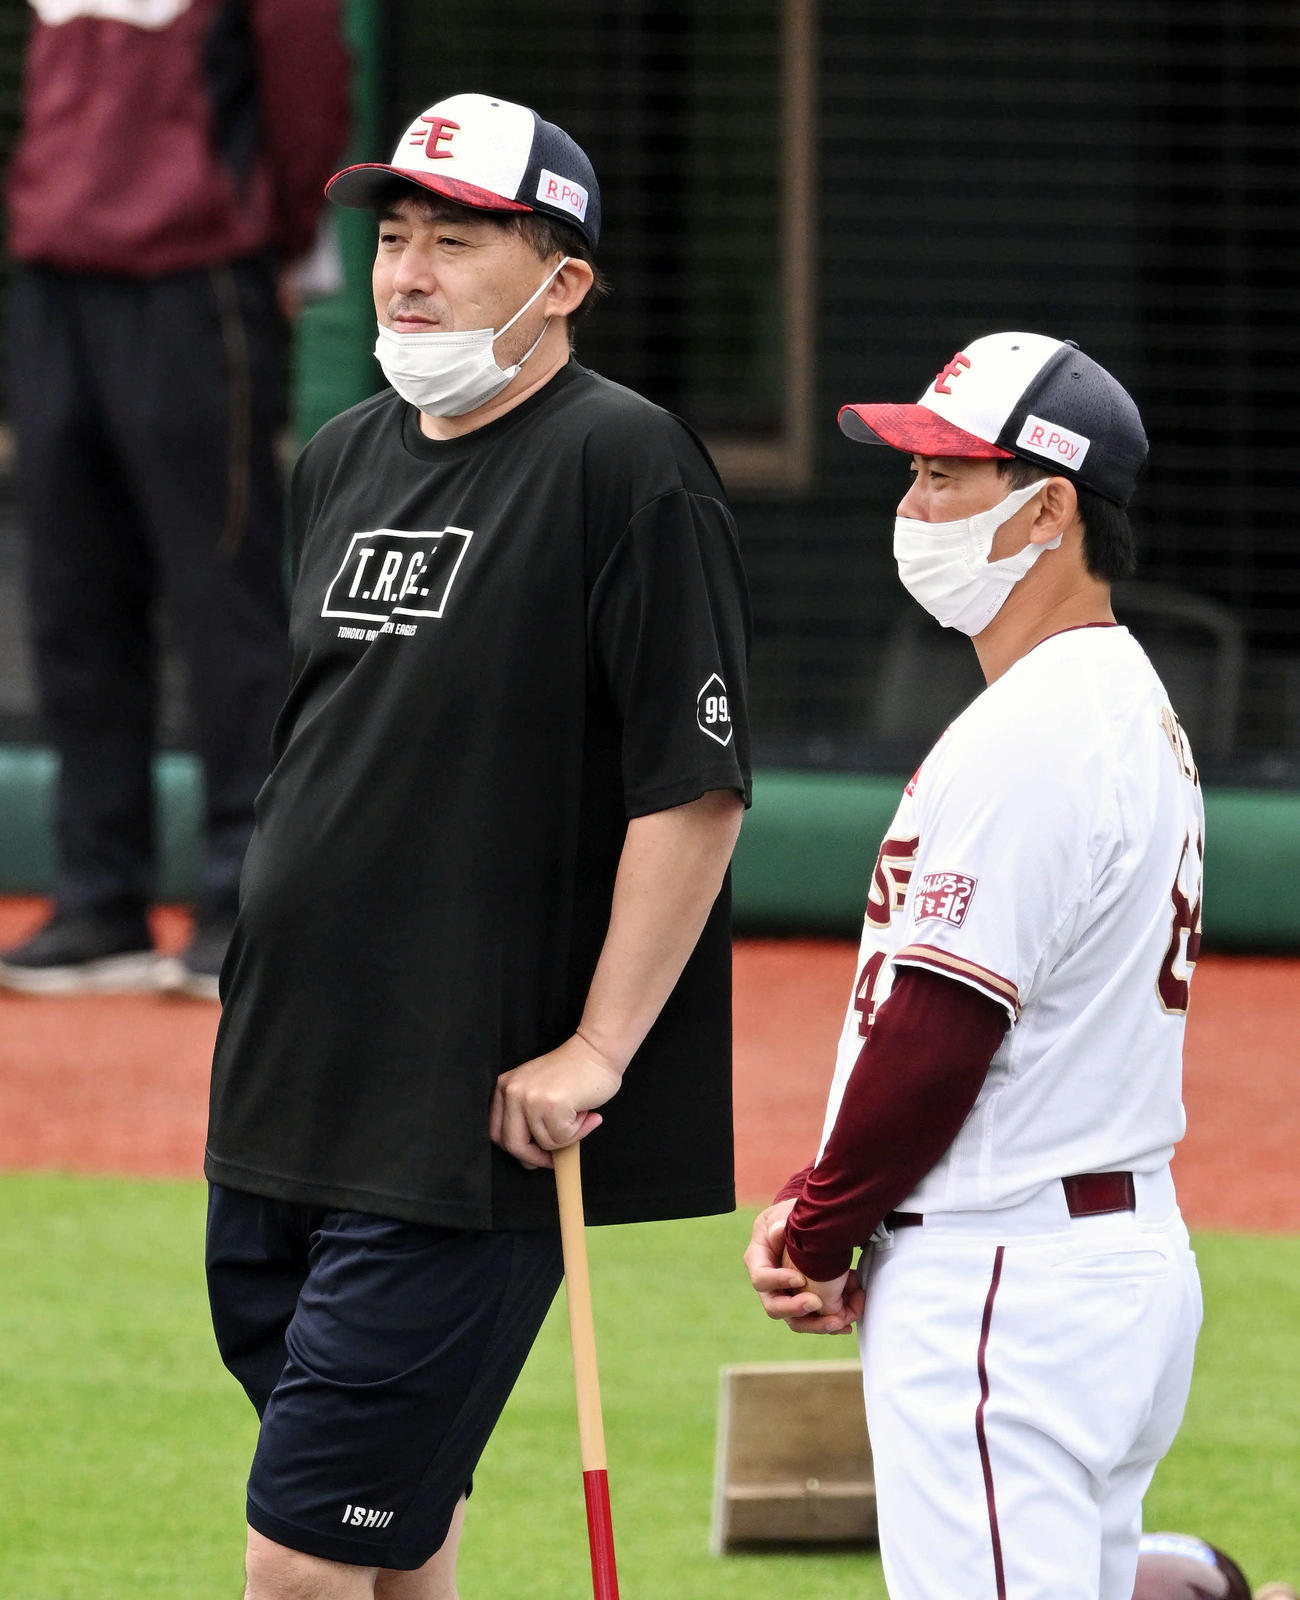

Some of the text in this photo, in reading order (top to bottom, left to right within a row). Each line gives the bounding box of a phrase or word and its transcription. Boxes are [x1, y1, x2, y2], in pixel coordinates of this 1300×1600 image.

[545, 179, 585, 212] R Pay
[1027, 425, 1081, 461] R Pay
[337, 626, 366, 641] TOHOKU
[341, 1504, 395, 1528] ISHII
